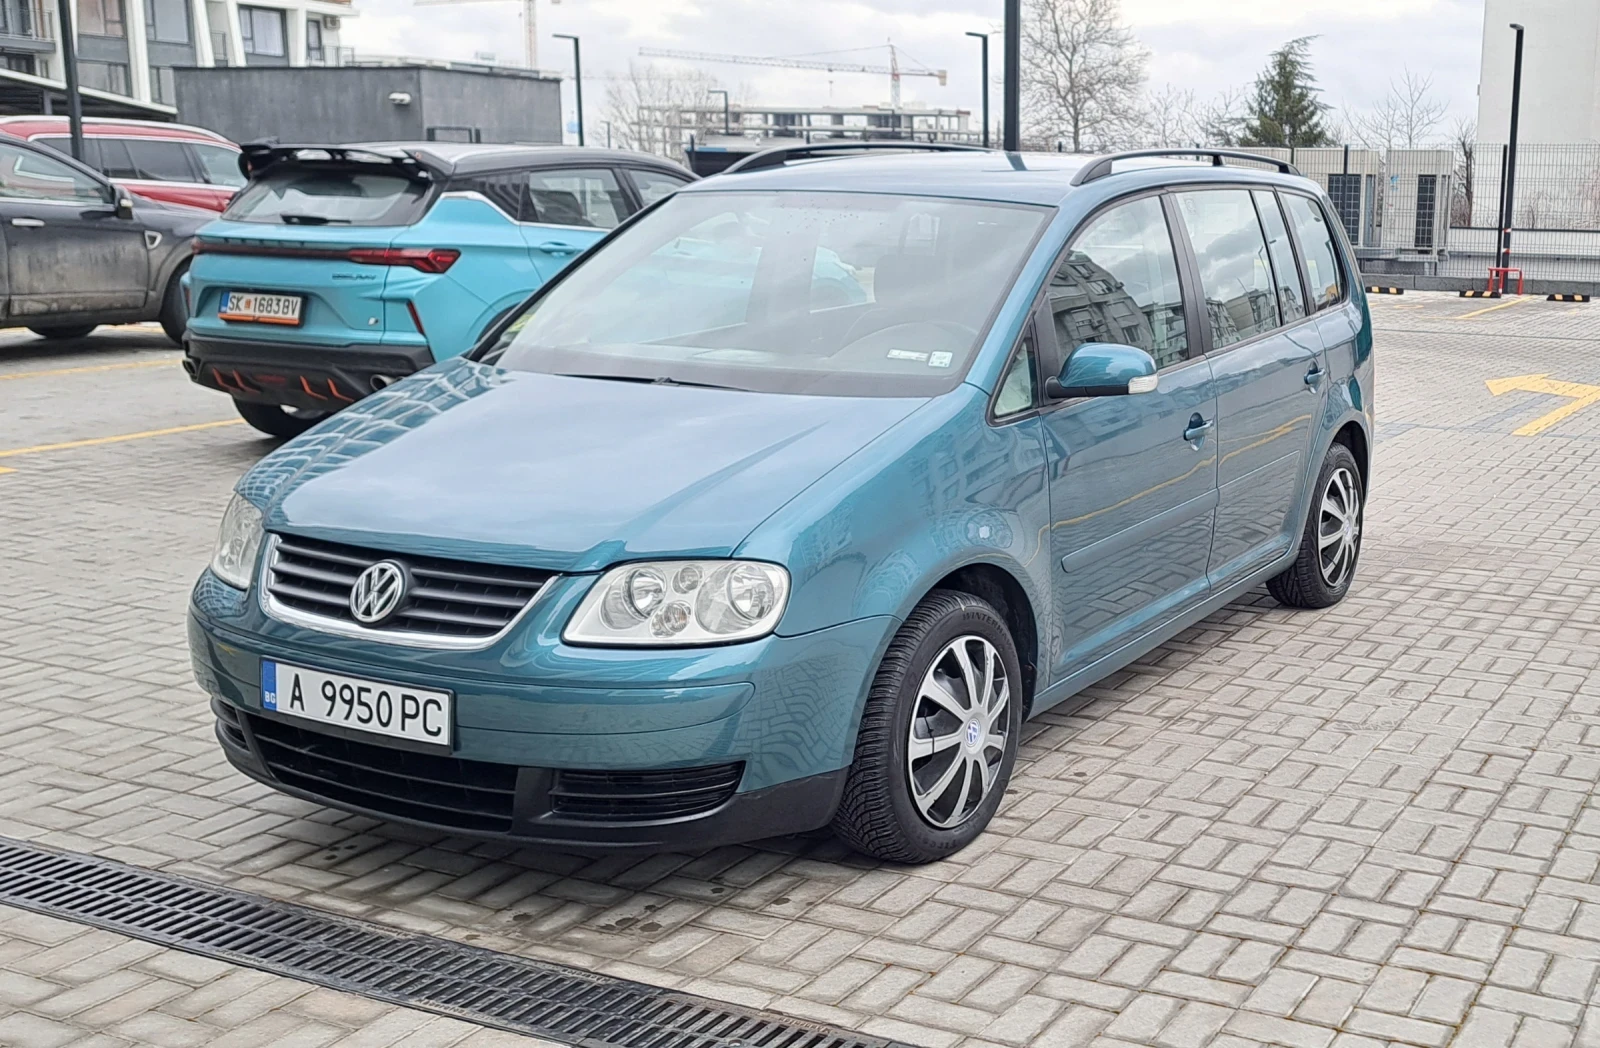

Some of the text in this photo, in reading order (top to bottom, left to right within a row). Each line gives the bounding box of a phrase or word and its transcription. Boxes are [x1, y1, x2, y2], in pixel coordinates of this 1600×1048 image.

[228, 295, 244, 312] SK
[264, 690, 276, 704] BG
[289, 673, 305, 712] A
